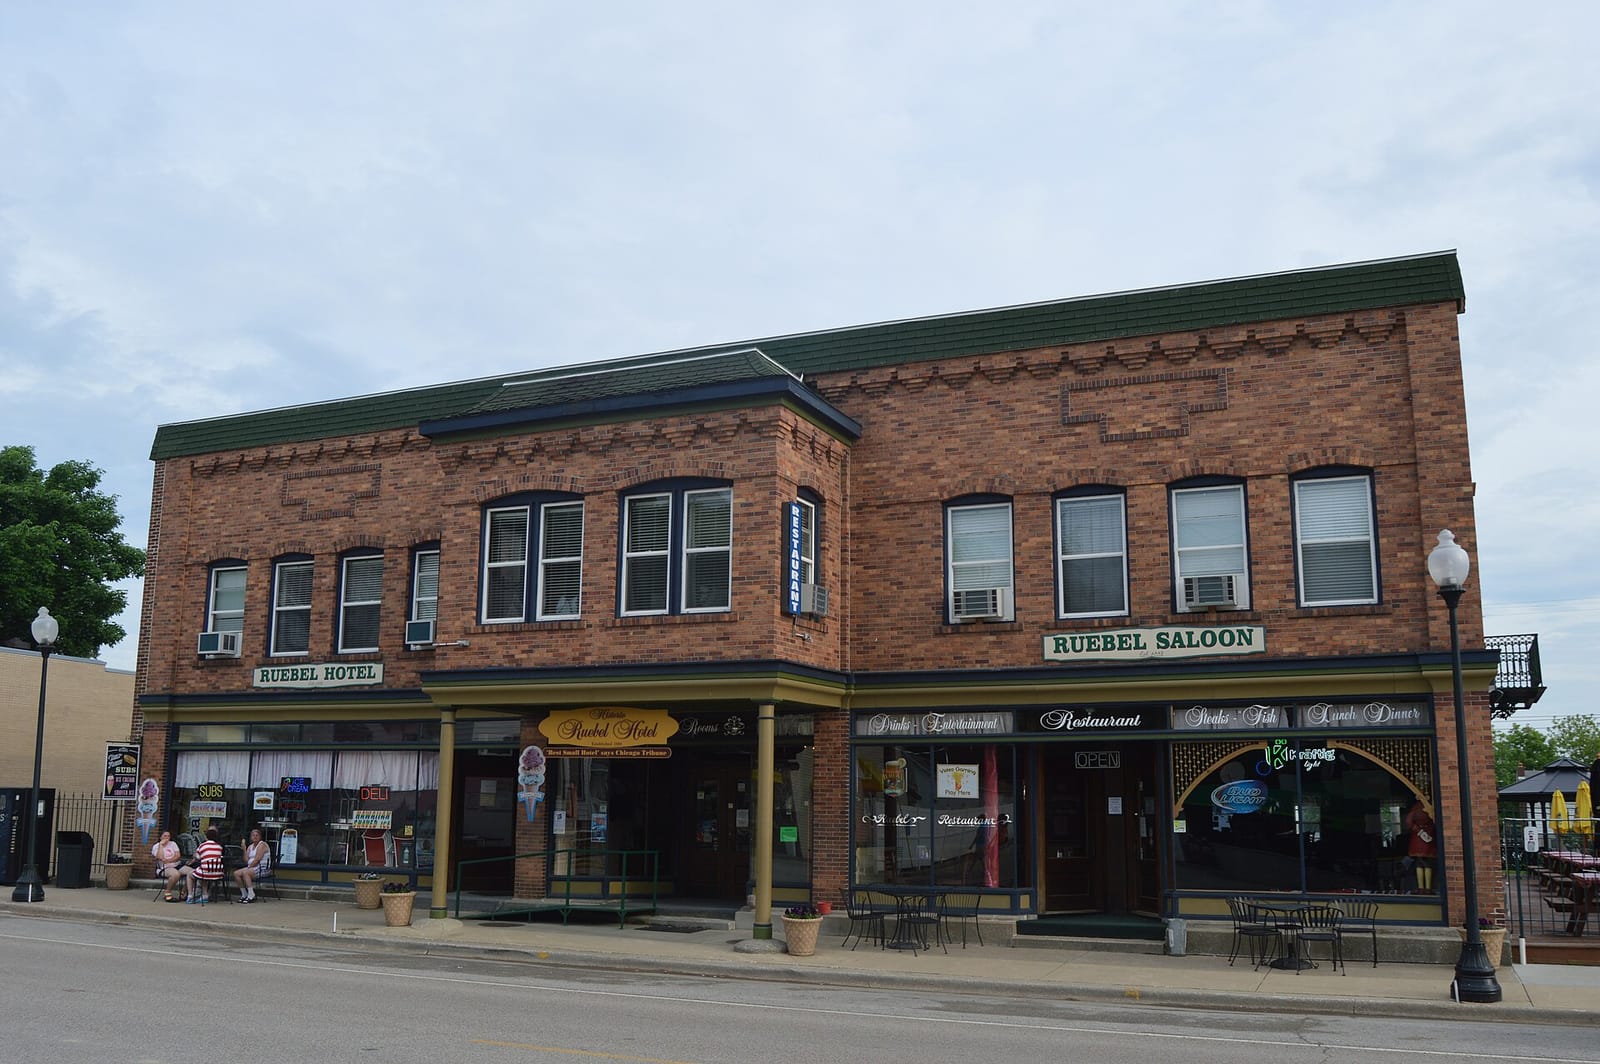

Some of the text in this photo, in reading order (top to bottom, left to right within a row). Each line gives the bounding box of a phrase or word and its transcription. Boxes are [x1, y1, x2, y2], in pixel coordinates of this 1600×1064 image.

[791, 505, 799, 611] RESTAURANT
[1053, 629, 1253, 653] RUEBEL SALOON
[260, 665, 376, 682] RUEBEL HOTEL
[1040, 709, 1141, 730] Restaurant
[1185, 705, 1229, 727] Steaks
[1243, 704, 1277, 725] Fish
[1307, 702, 1420, 725] Lunch Dinner
[557, 719, 658, 740] Ruebel Hotel
[680, 717, 719, 735] Rooms
[868, 713, 910, 733] Drinks
[922, 712, 998, 732] Entertainment
[1077, 752, 1119, 767] OPEN
[115, 766, 136, 774] SUBS
[199, 785, 223, 798] SUBS
[287, 785, 309, 793] CREAM
[361, 787, 388, 800] DELI
[1227, 786, 1261, 796] BUD
[1220, 794, 1266, 804] LIGHT
[938, 814, 999, 825] Restaurant
